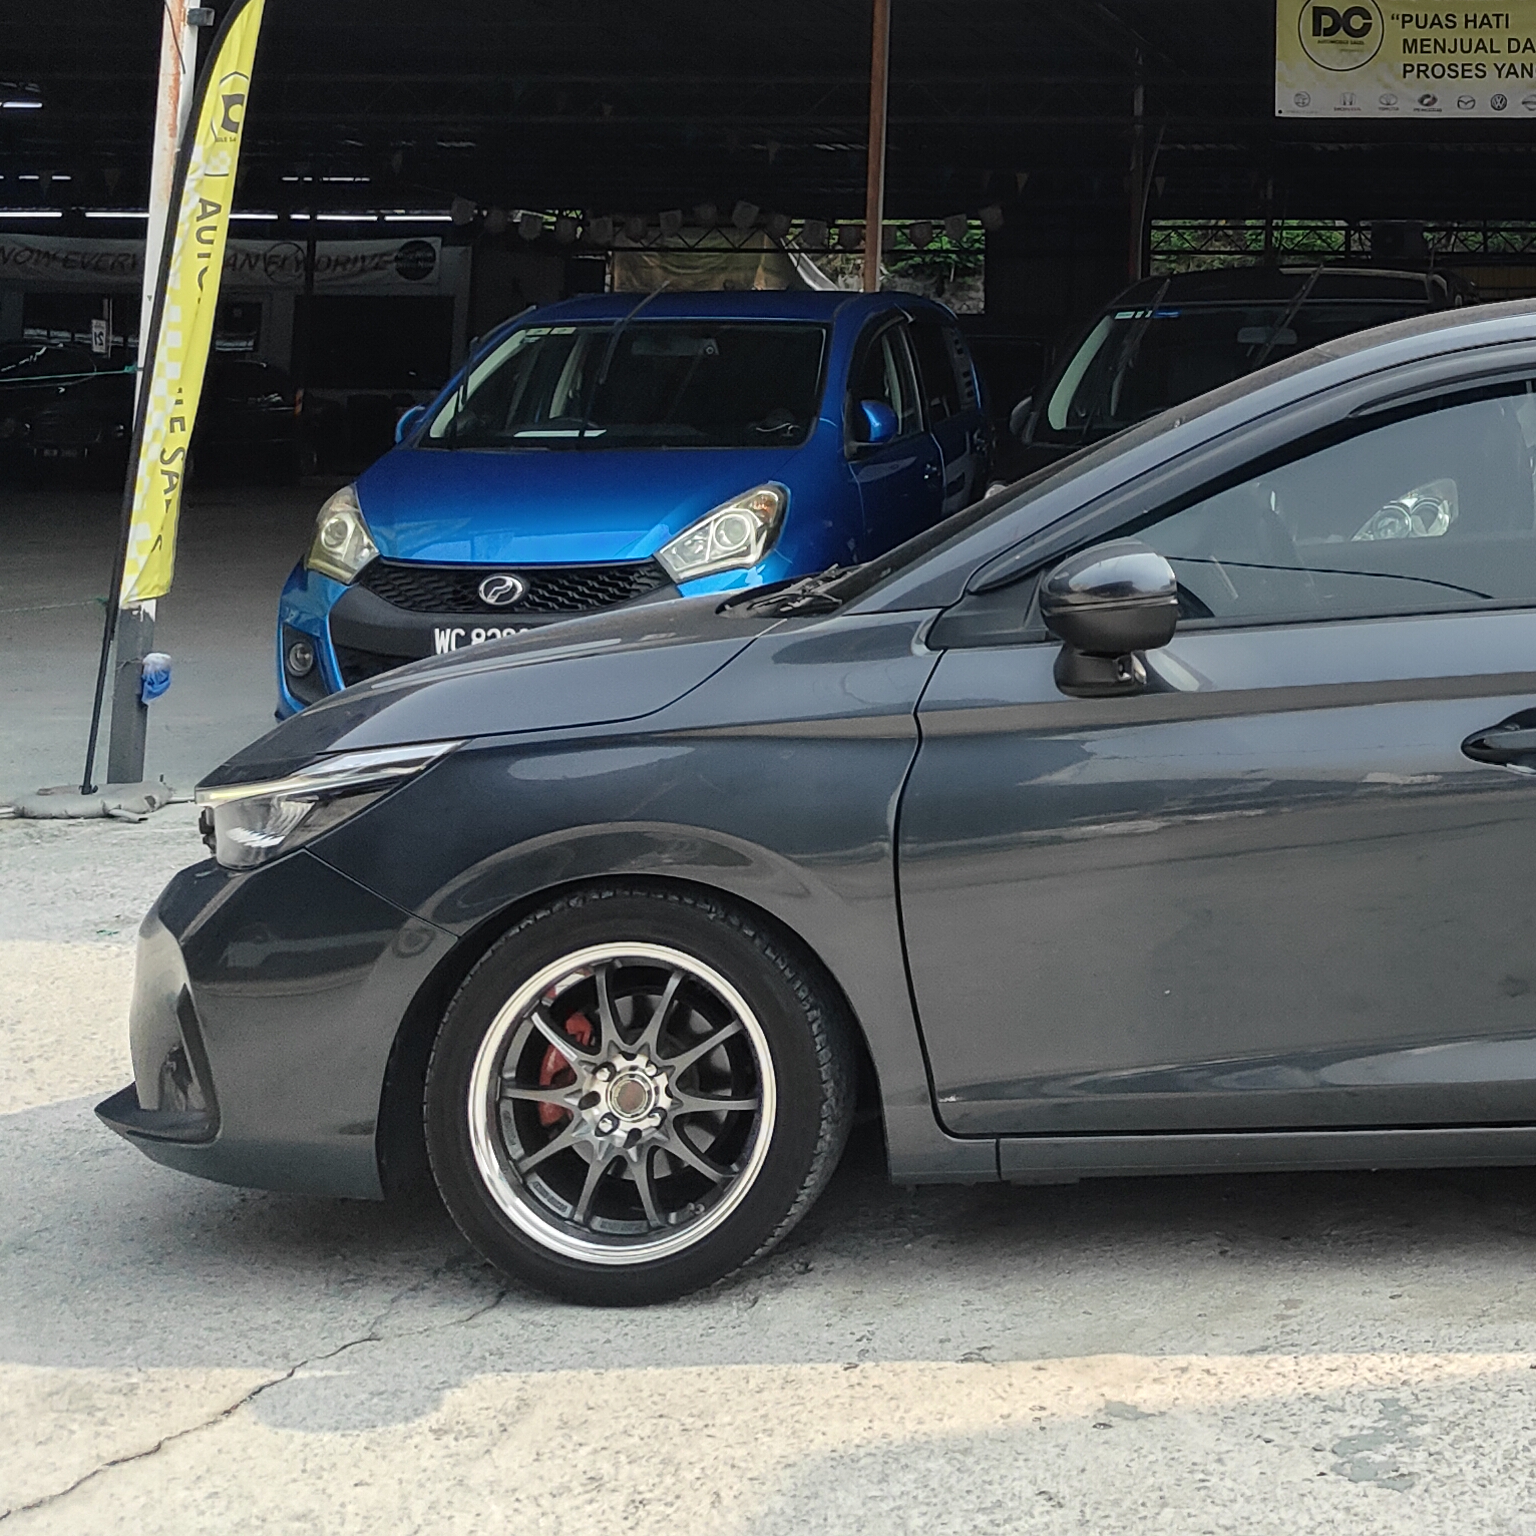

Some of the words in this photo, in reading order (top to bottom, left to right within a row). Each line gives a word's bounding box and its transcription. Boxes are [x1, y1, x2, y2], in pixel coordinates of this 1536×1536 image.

[1312, 6, 1373, 38] DC
[1464, 13, 1510, 29] HATI
[1403, 38, 1501, 54] MENJUAL
[1403, 63, 1487, 79] PROSES
